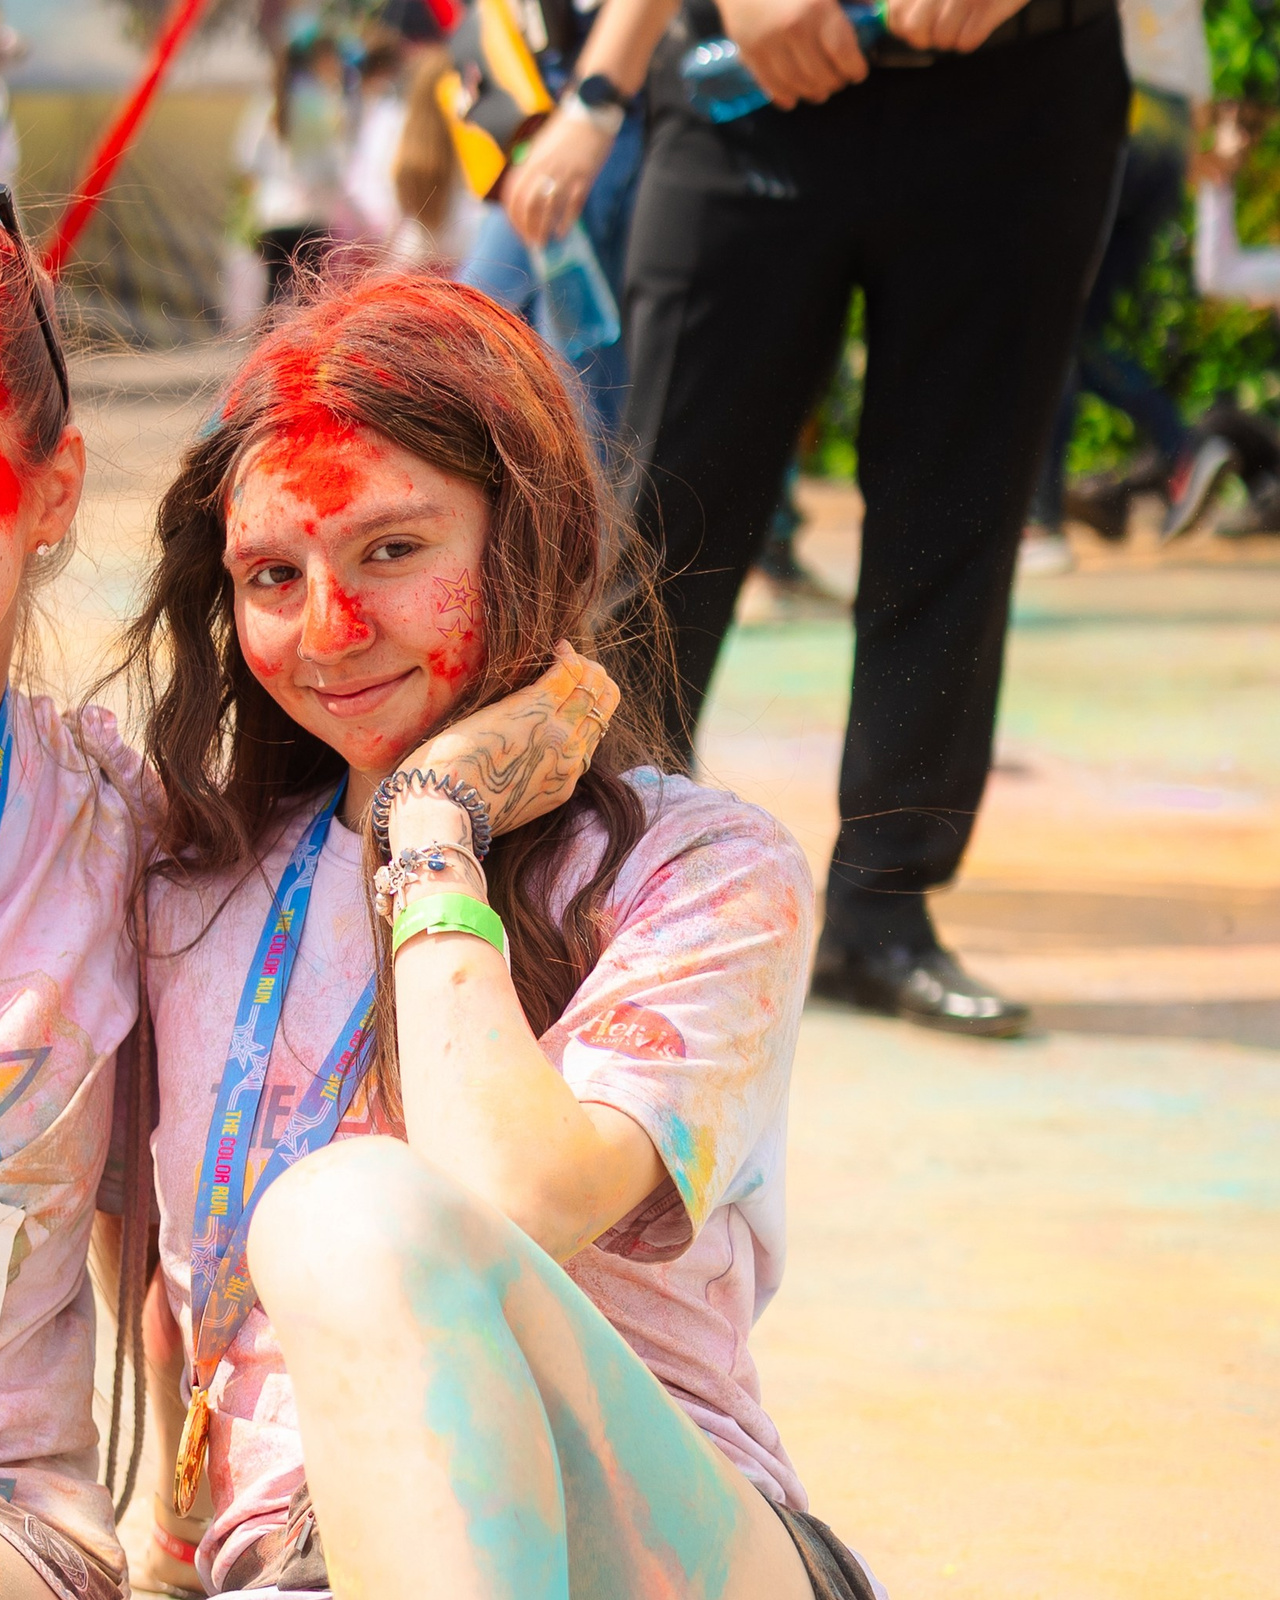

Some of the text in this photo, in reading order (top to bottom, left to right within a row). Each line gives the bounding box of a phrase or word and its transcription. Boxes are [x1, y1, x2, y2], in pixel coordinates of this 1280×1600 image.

[253, 908, 295, 1004] THE COLOR RUN
[210, 1110, 243, 1216] THE COLOR RUN
